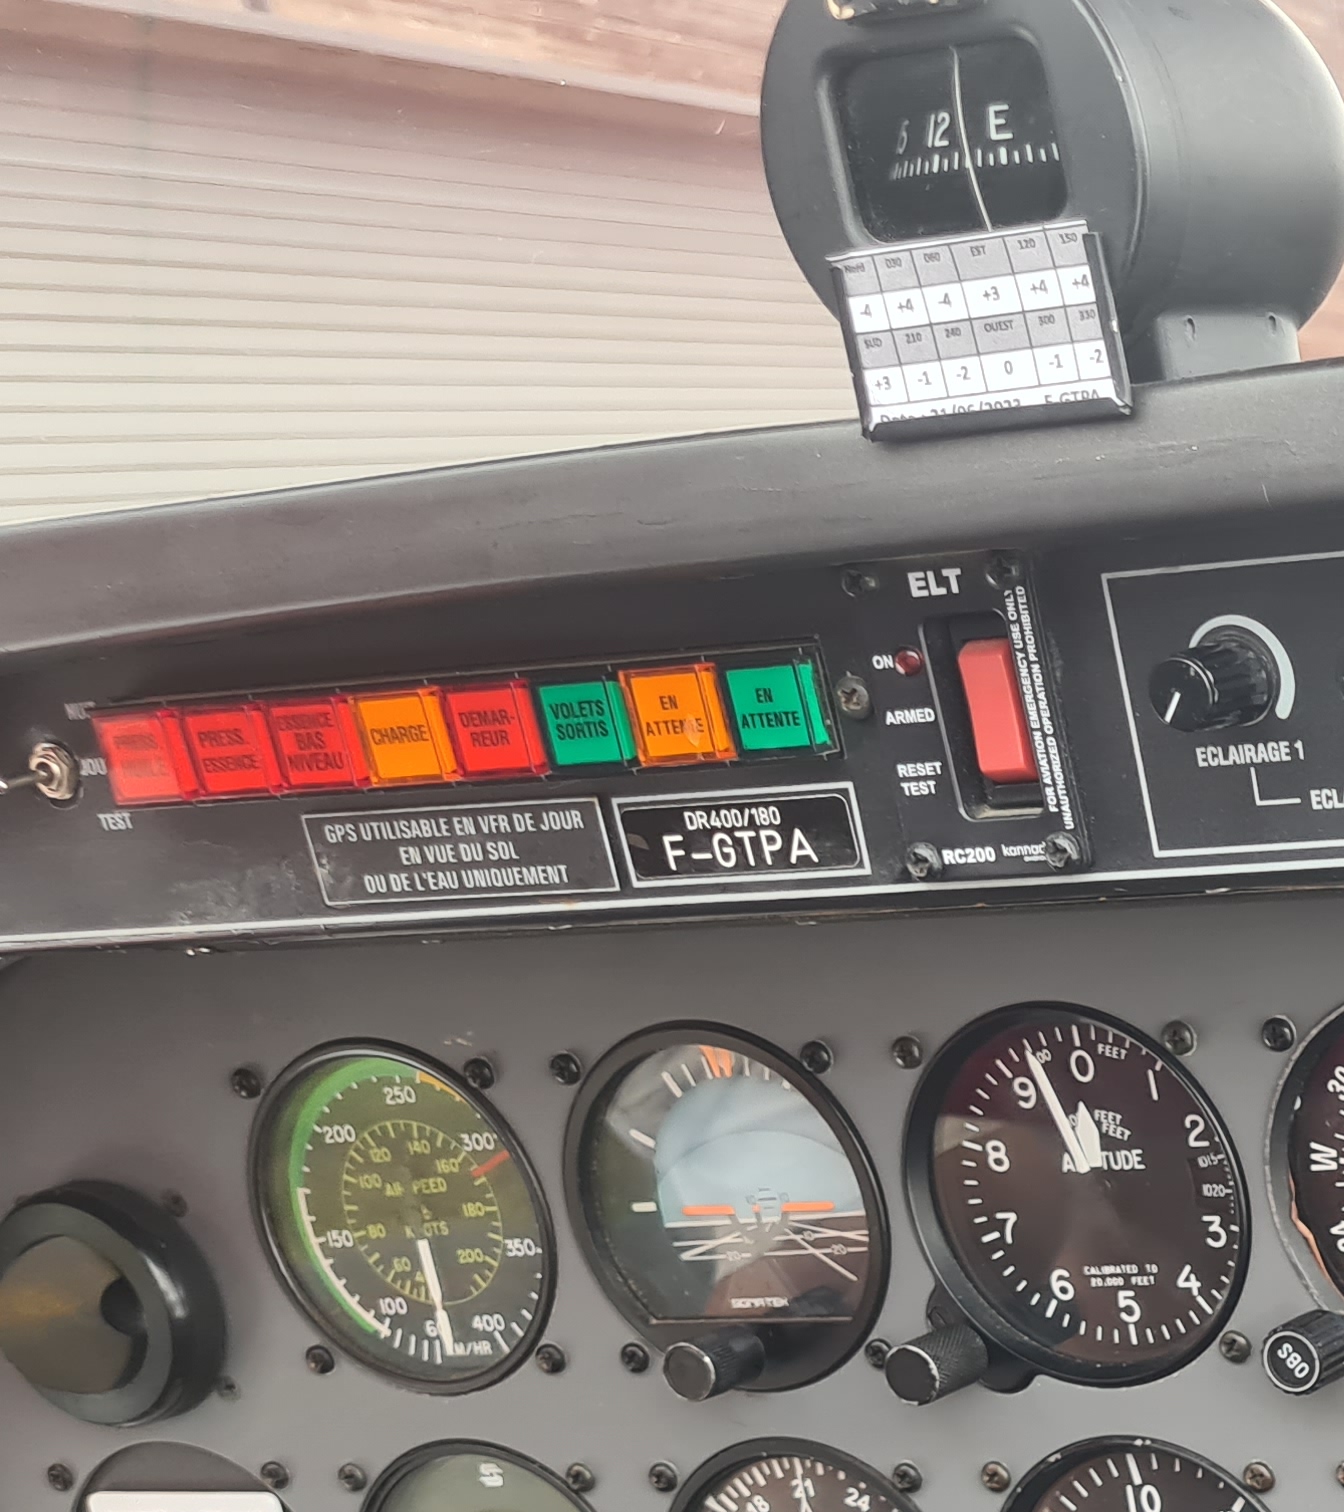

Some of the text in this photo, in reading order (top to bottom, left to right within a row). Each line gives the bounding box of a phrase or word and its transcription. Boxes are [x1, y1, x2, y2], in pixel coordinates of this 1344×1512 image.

[988, 104, 1013, 141] E
[907, 568, 962, 599] ELT
[872, 654, 894, 670] ON
[658, 694, 679, 712] EN
[755, 687, 773, 705] EN
[459, 710, 516, 729] DEMAR-
[548, 699, 606, 720] VOLETS
[885, 707, 936, 726] ARMED
[556, 719, 610, 742] SORTIS
[740, 711, 802, 730] ATTENTE
[370, 724, 431, 747] CHARGE
[470, 729, 511, 748] REUR
[1195, 740, 1305, 767] ECLAIRAGE 1
[897, 761, 943, 778] RESET
[900, 780, 937, 796] TEST
[323, 810, 585, 845] GPS UTILISABLE EN VFR DE JOUR
[398, 839, 520, 867] EN VUE DU SOL
[662, 828, 819, 872] F-GTPA
[941, 845, 996, 865] RC200
[363, 864, 571, 896] OU DE L'EAU UNIQUEMENT
[383, 1085, 416, 1106] 250
[323, 1123, 357, 1144] 200
[460, 1132, 494, 1152] 300
[1277, 1342, 1310, 1379] OBS
